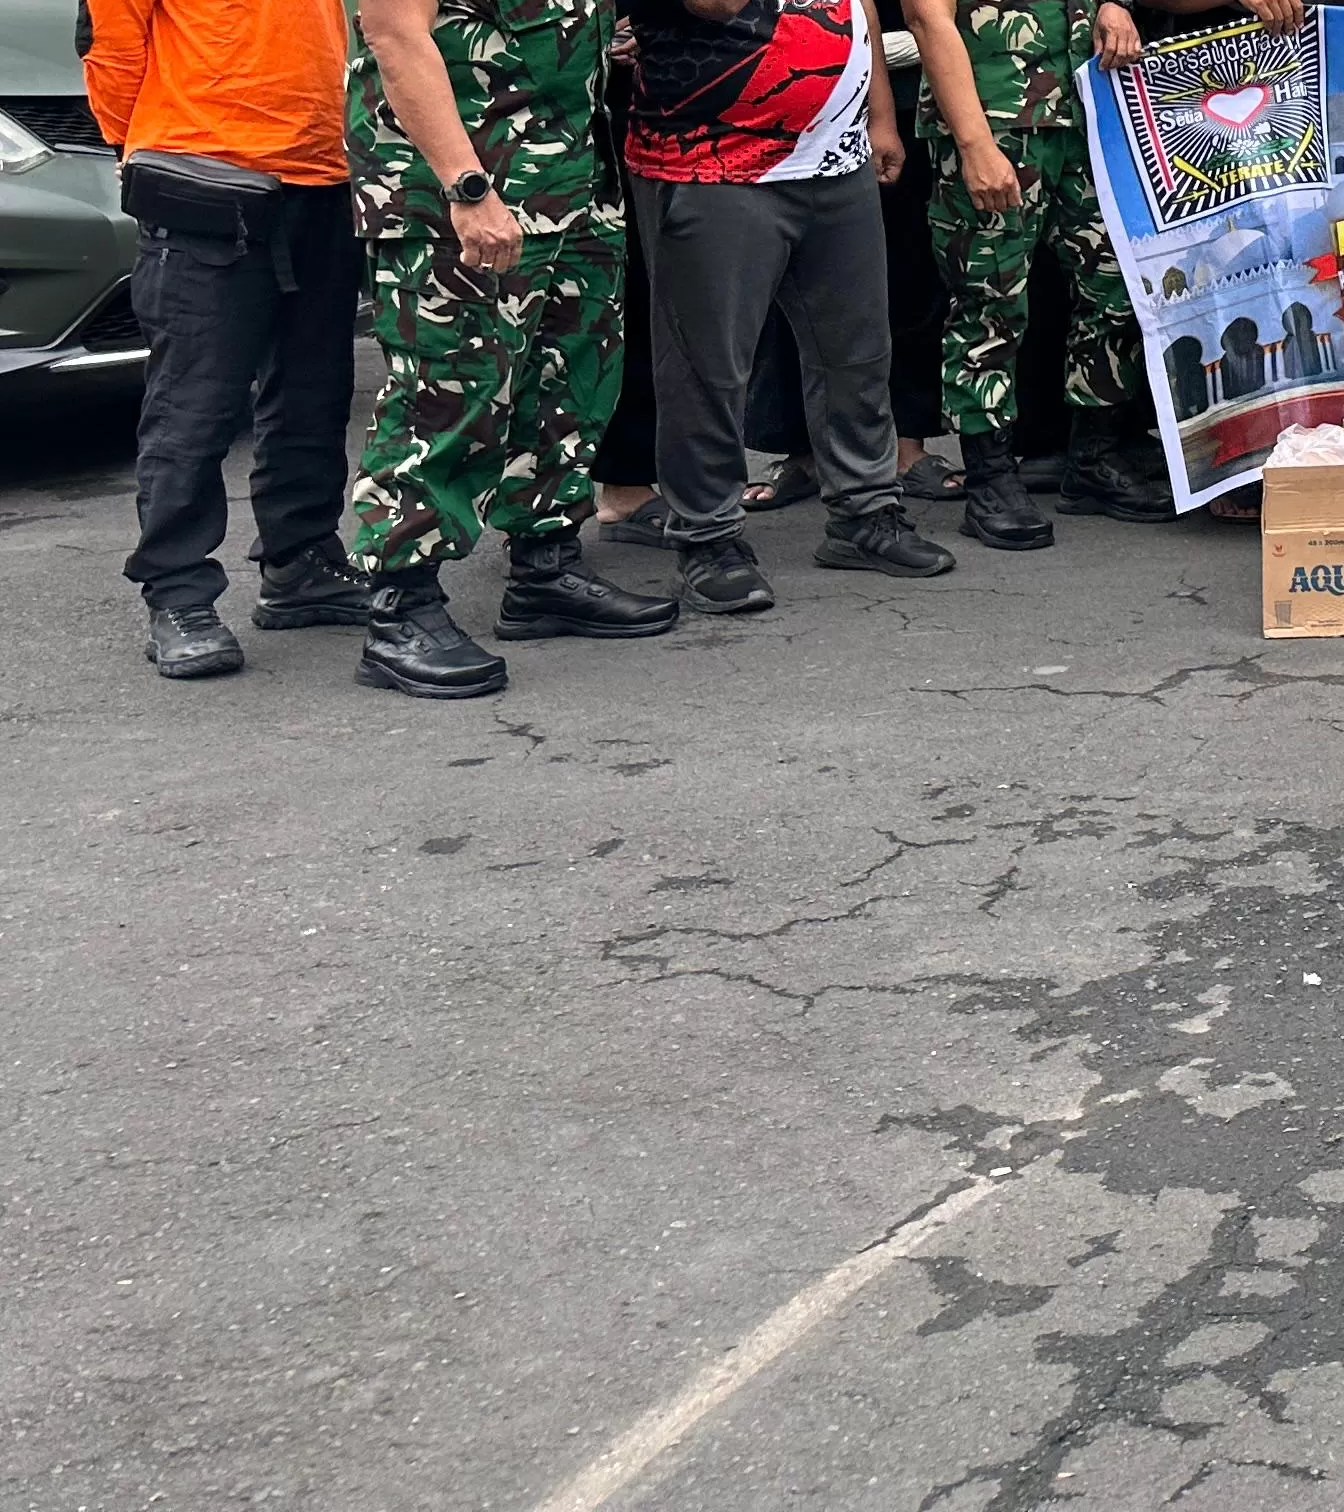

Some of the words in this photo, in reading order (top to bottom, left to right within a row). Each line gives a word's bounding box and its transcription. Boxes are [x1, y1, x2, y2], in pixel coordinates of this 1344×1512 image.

[1274, 80, 1308, 104] Hati
[1159, 109, 1204, 132] Setia
[1218, 159, 1286, 188] TERATE
